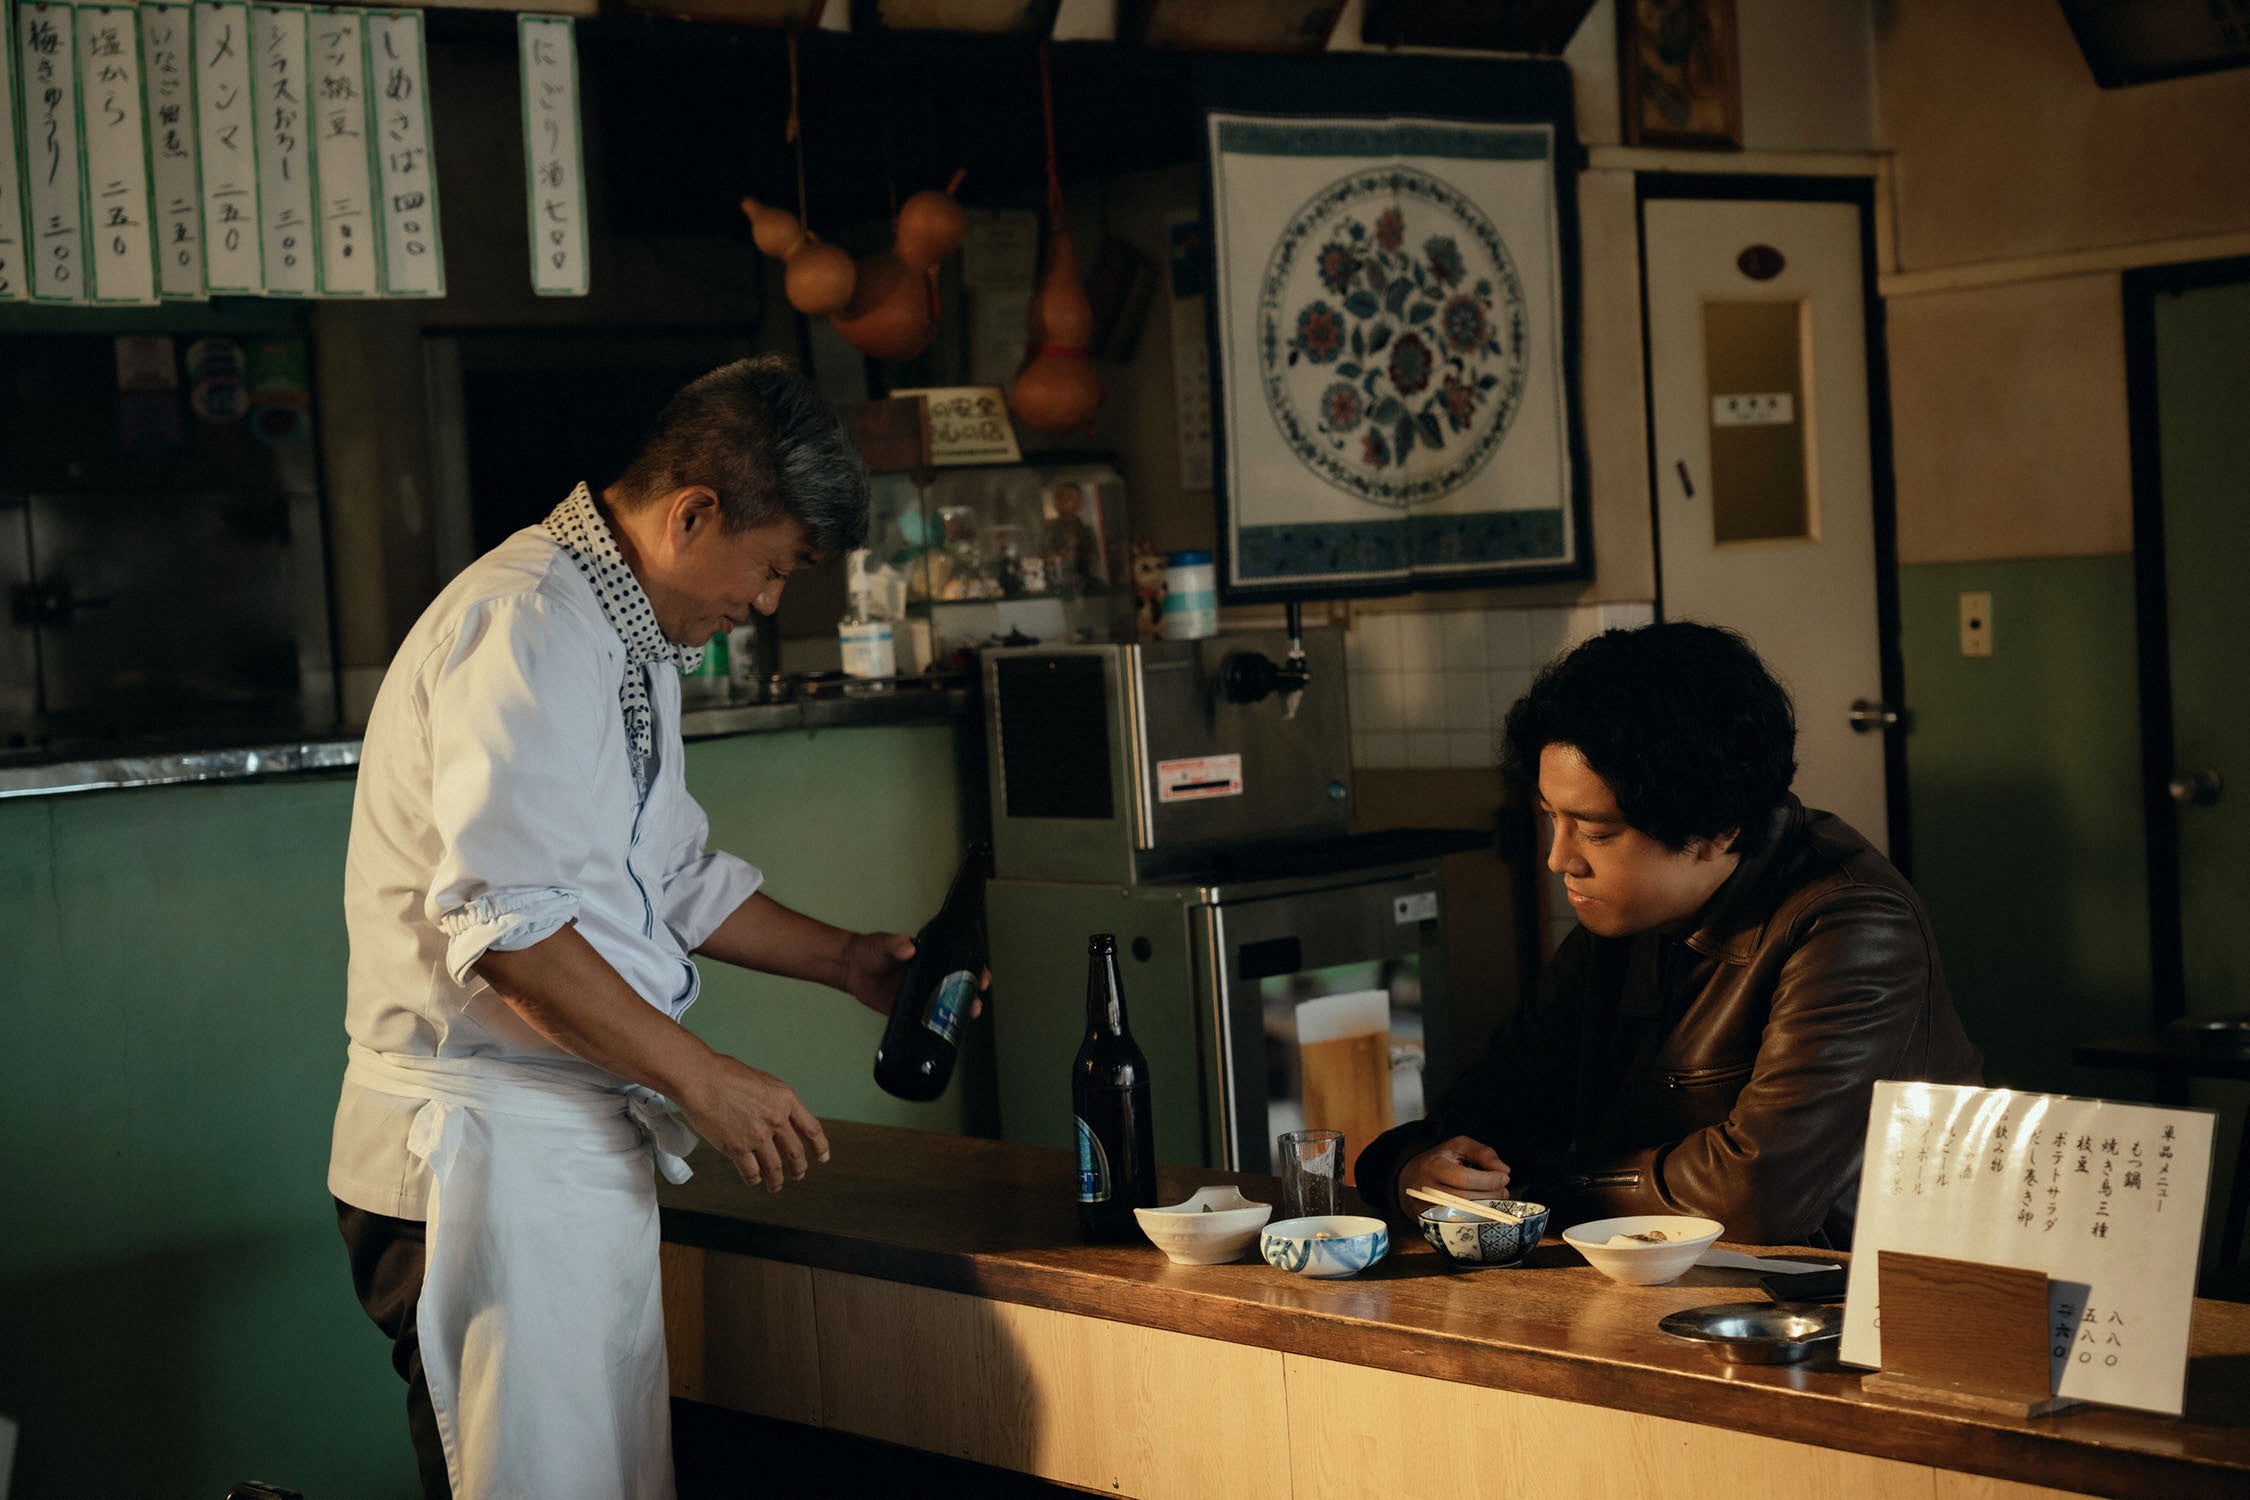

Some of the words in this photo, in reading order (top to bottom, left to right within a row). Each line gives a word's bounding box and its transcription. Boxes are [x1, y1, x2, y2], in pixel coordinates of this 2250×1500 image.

[209, 22, 240, 151] メンマ
[2073, 1135, 2094, 1175] 枝豆
[2091, 1136, 2119, 1239] 焼き鳥三種
[2122, 1140, 2143, 1191] もつ鍋
[2155, 1124, 2177, 1214] 単品メニュー
